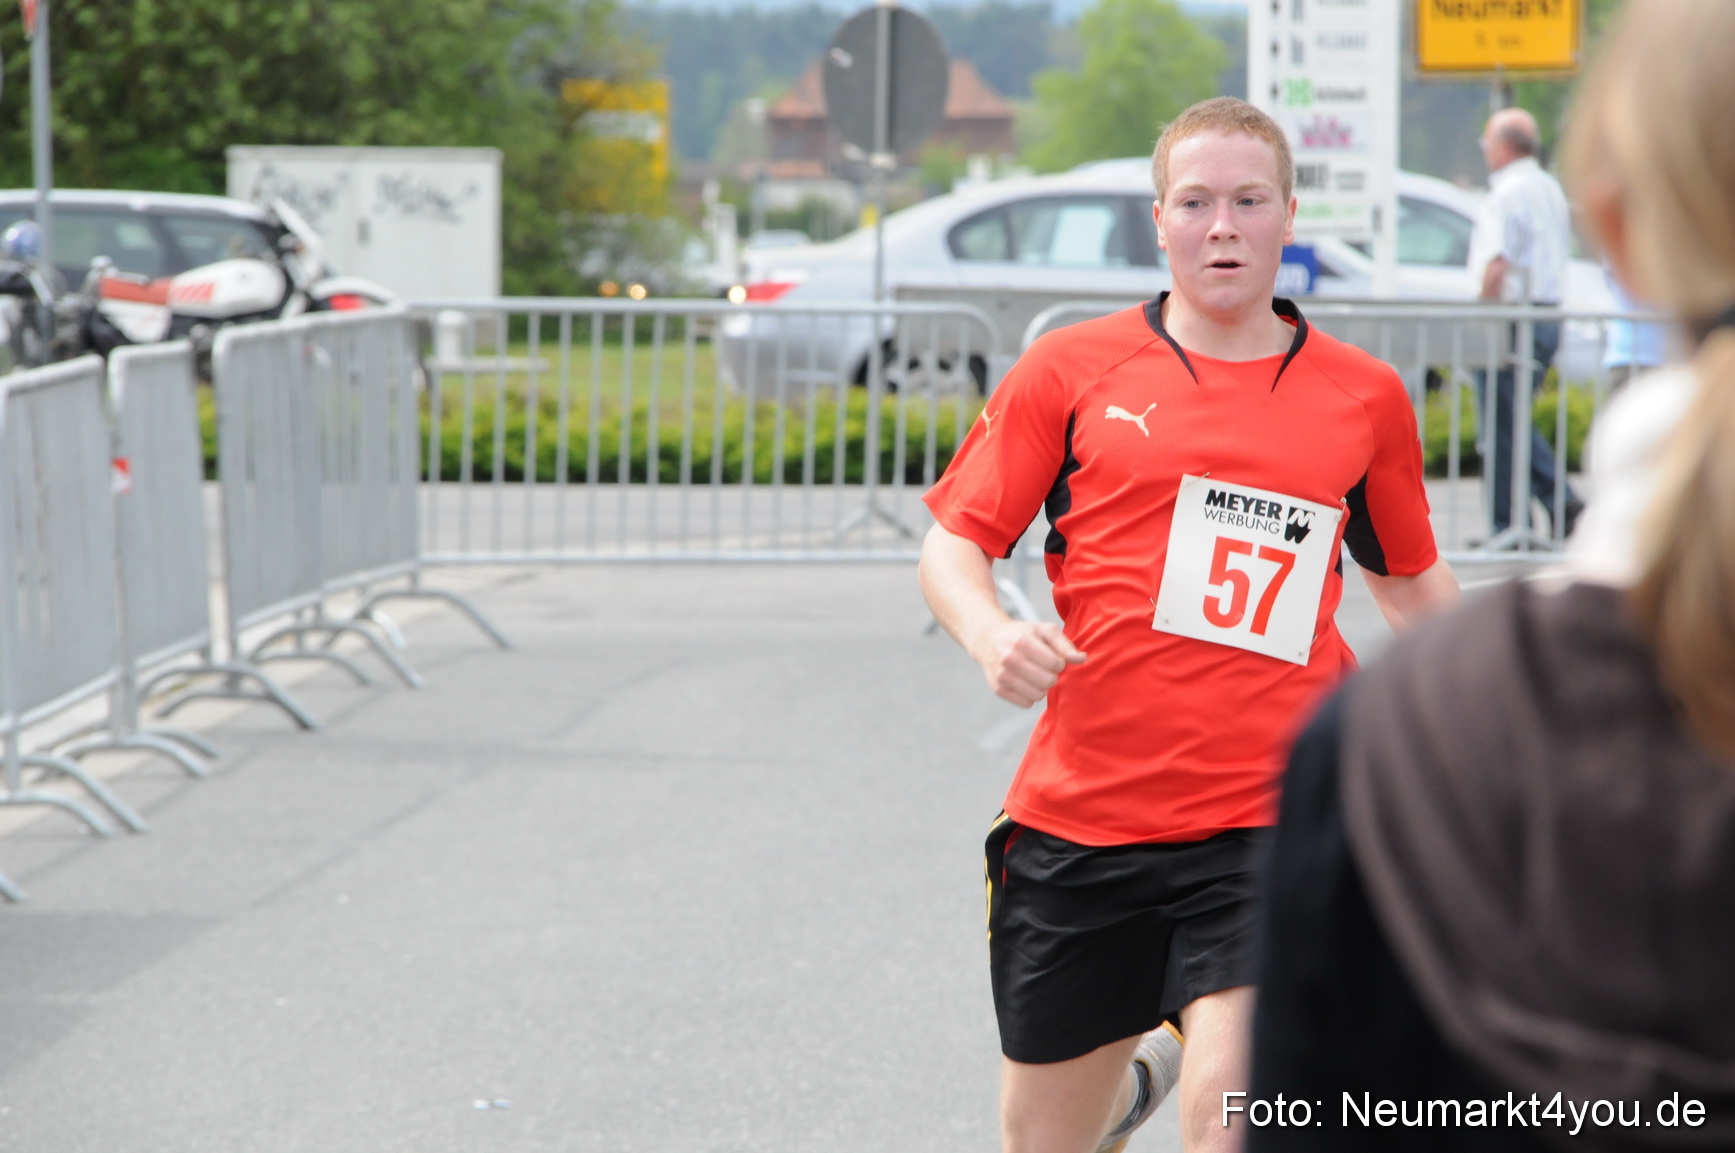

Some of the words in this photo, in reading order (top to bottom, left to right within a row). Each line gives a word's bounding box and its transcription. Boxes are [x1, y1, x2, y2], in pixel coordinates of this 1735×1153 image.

[1205, 489, 1283, 521] MEYER
[1204, 508, 1280, 535] WERBUNG
[1202, 535, 1297, 637] 57
